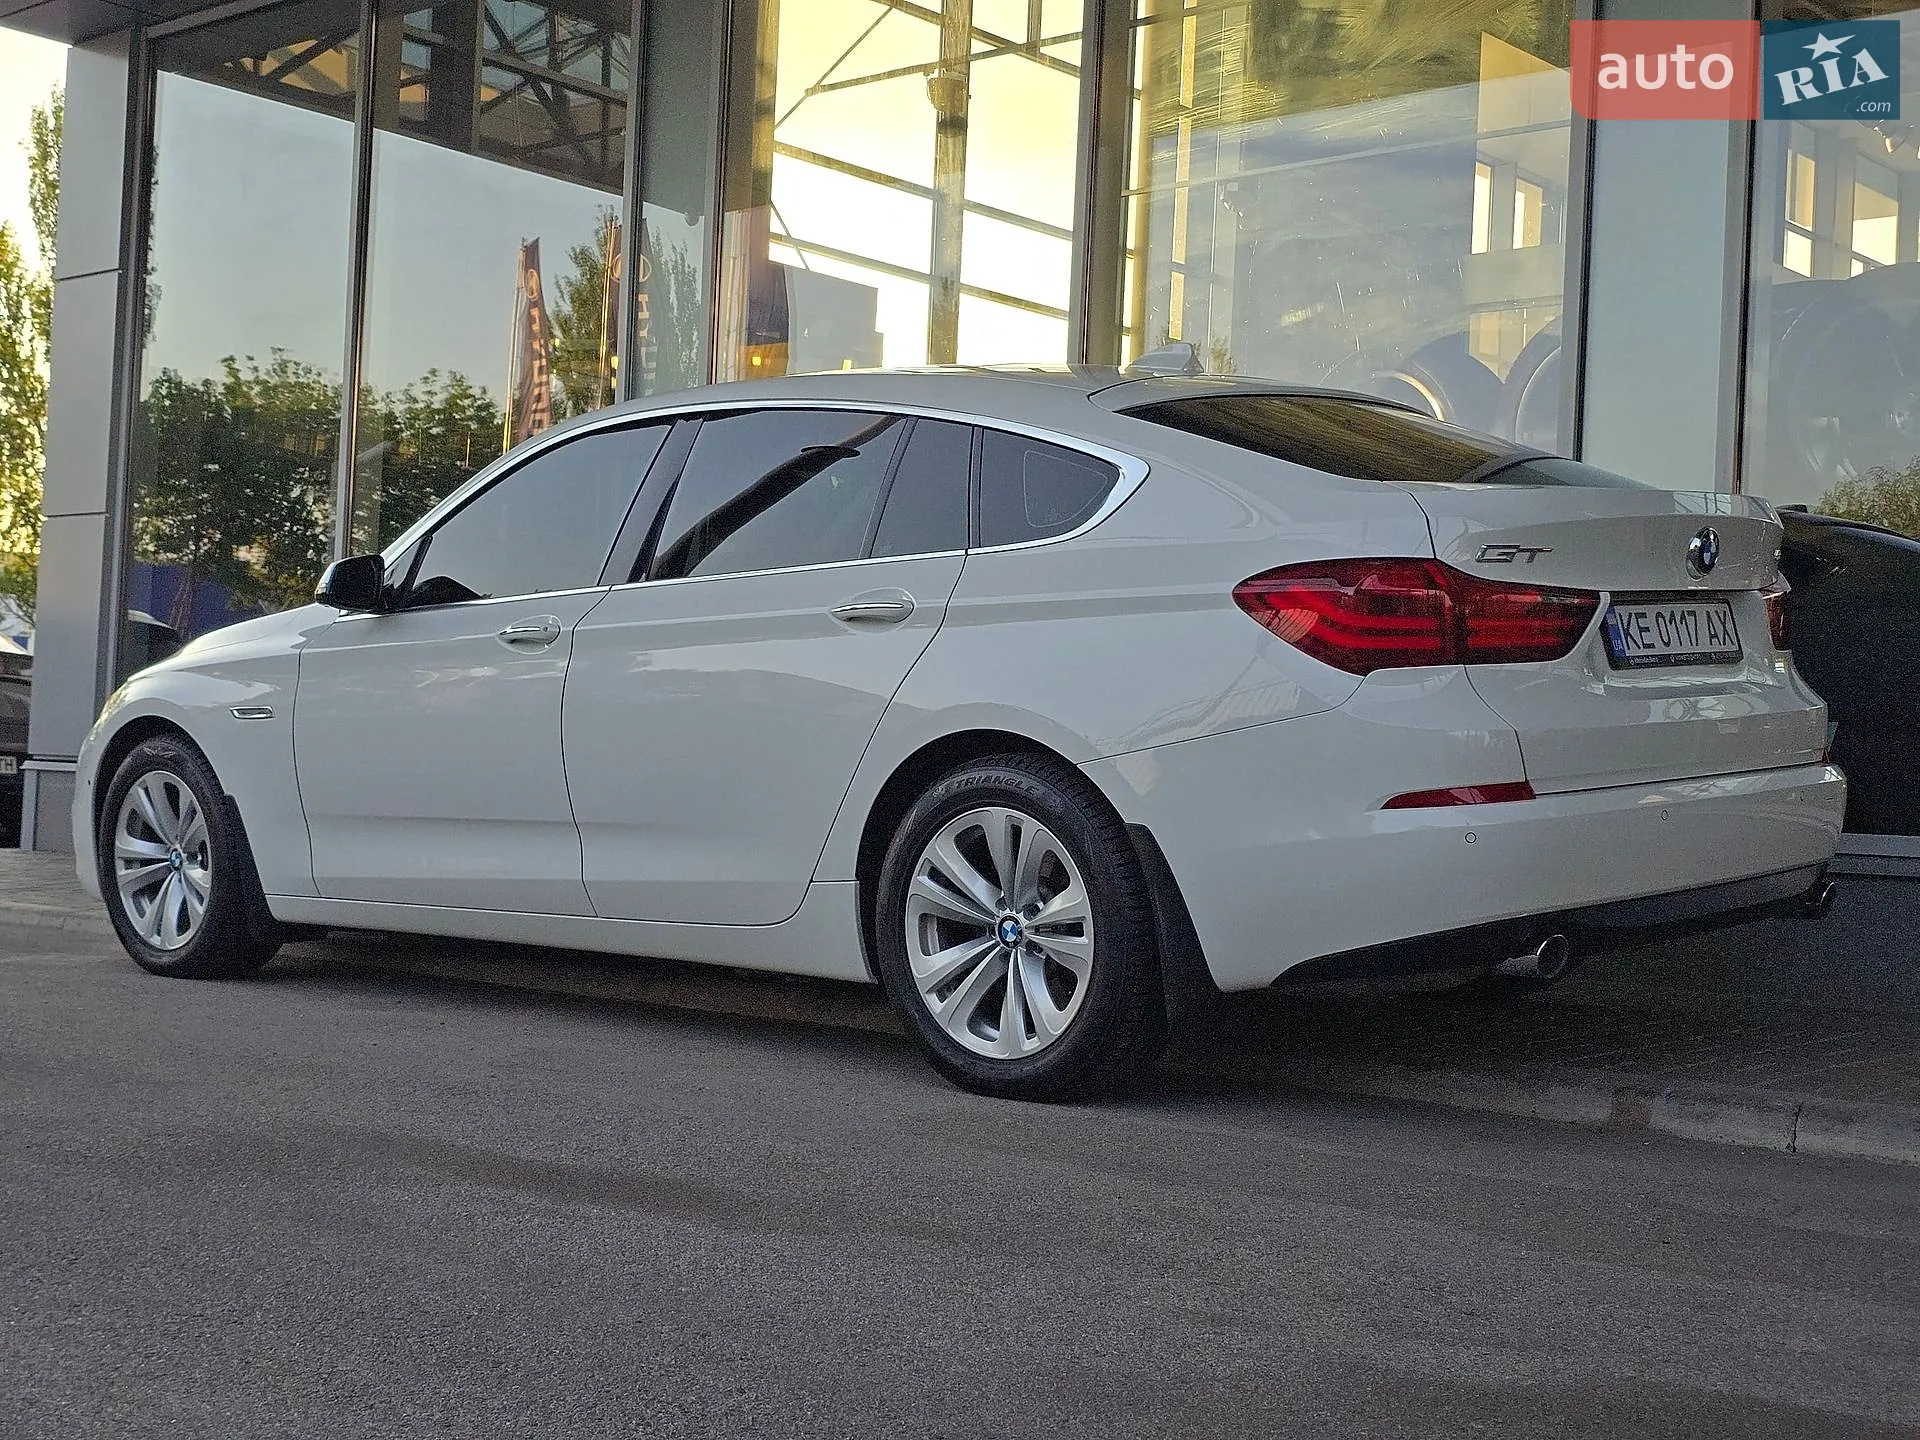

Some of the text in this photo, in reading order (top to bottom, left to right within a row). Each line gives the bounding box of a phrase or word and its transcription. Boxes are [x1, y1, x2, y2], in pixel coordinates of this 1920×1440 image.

[1475, 544, 1553, 563] GT
[1618, 610, 1735, 650] KE 0117 AX
[954, 775, 1040, 797] TRIANGLE
